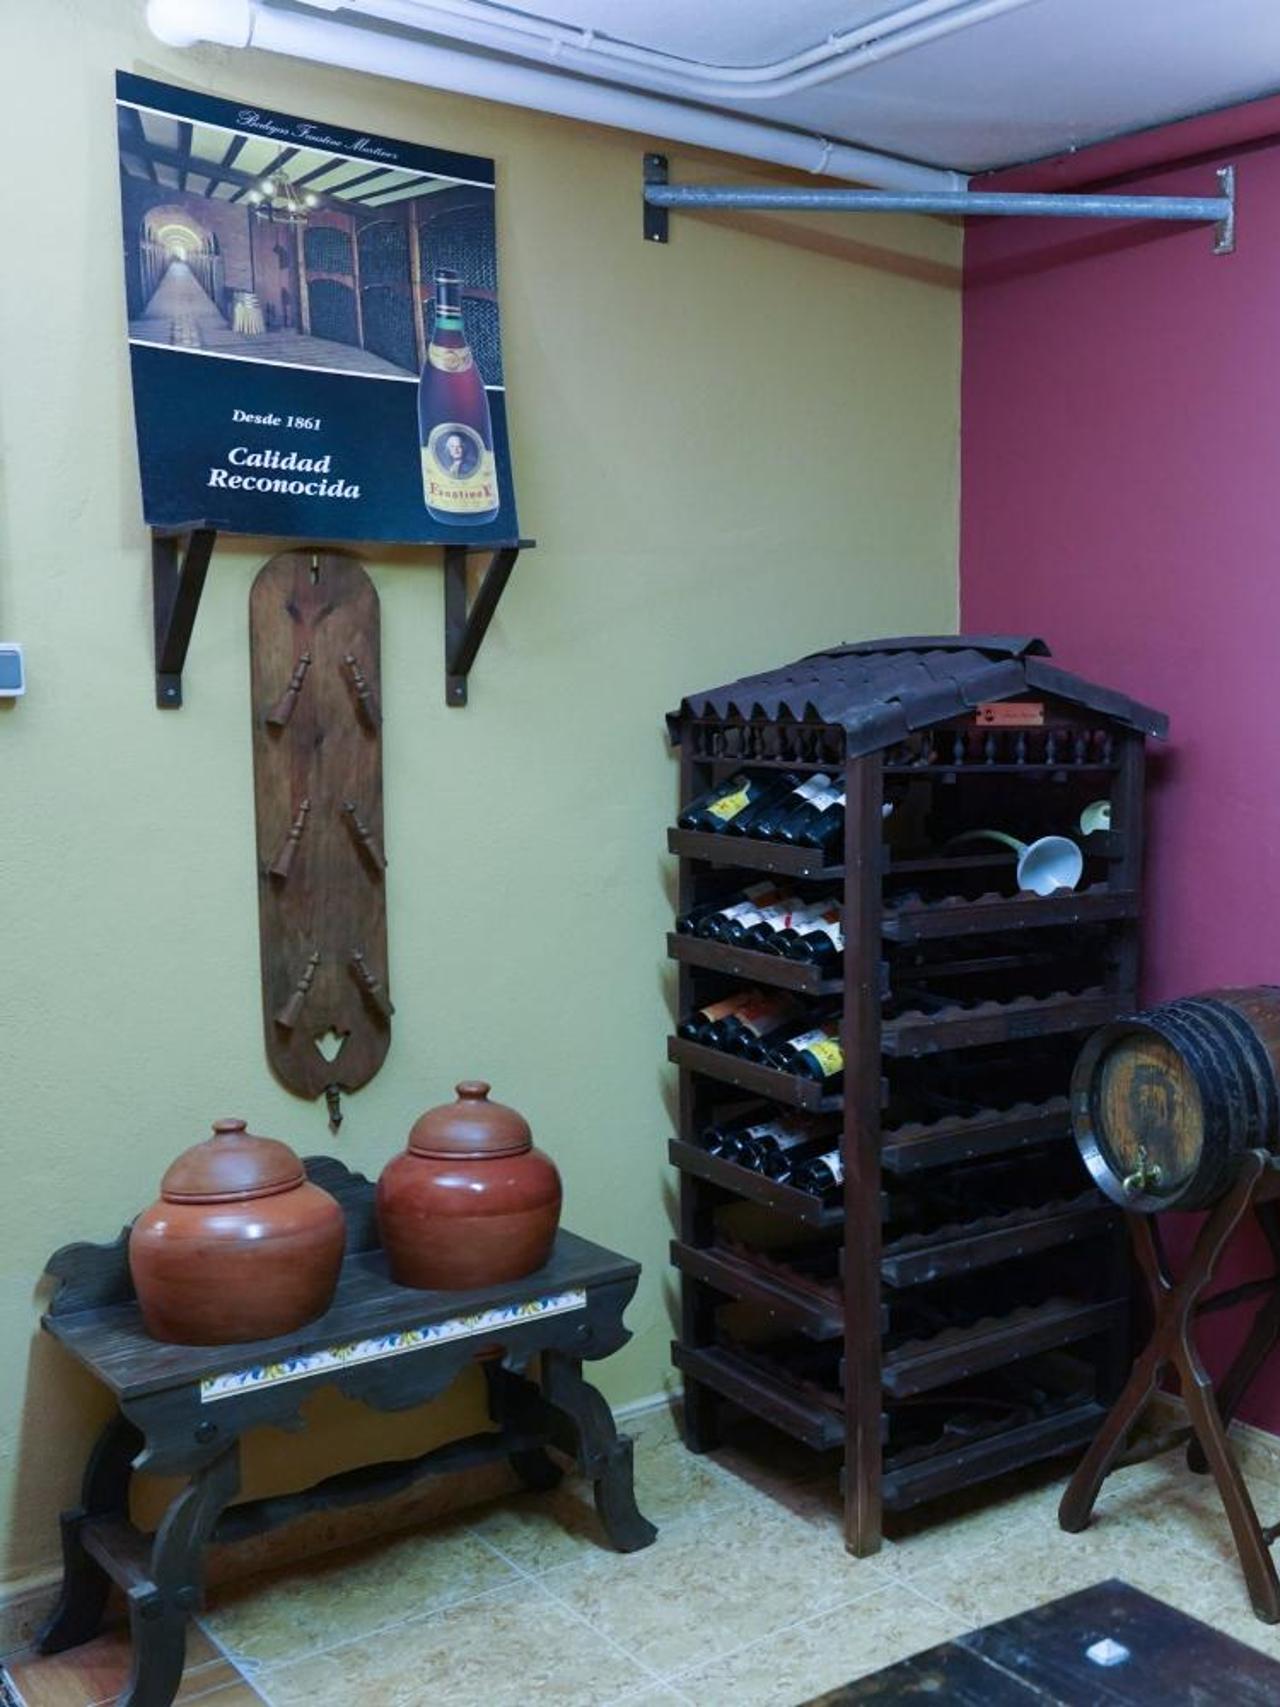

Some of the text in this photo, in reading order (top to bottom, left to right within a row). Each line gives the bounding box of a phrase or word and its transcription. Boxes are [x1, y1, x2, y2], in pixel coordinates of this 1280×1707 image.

[231, 409, 322, 432] Desde 1861
[228, 446, 333, 474] Calidad
[206, 468, 361, 499] Reconocida
